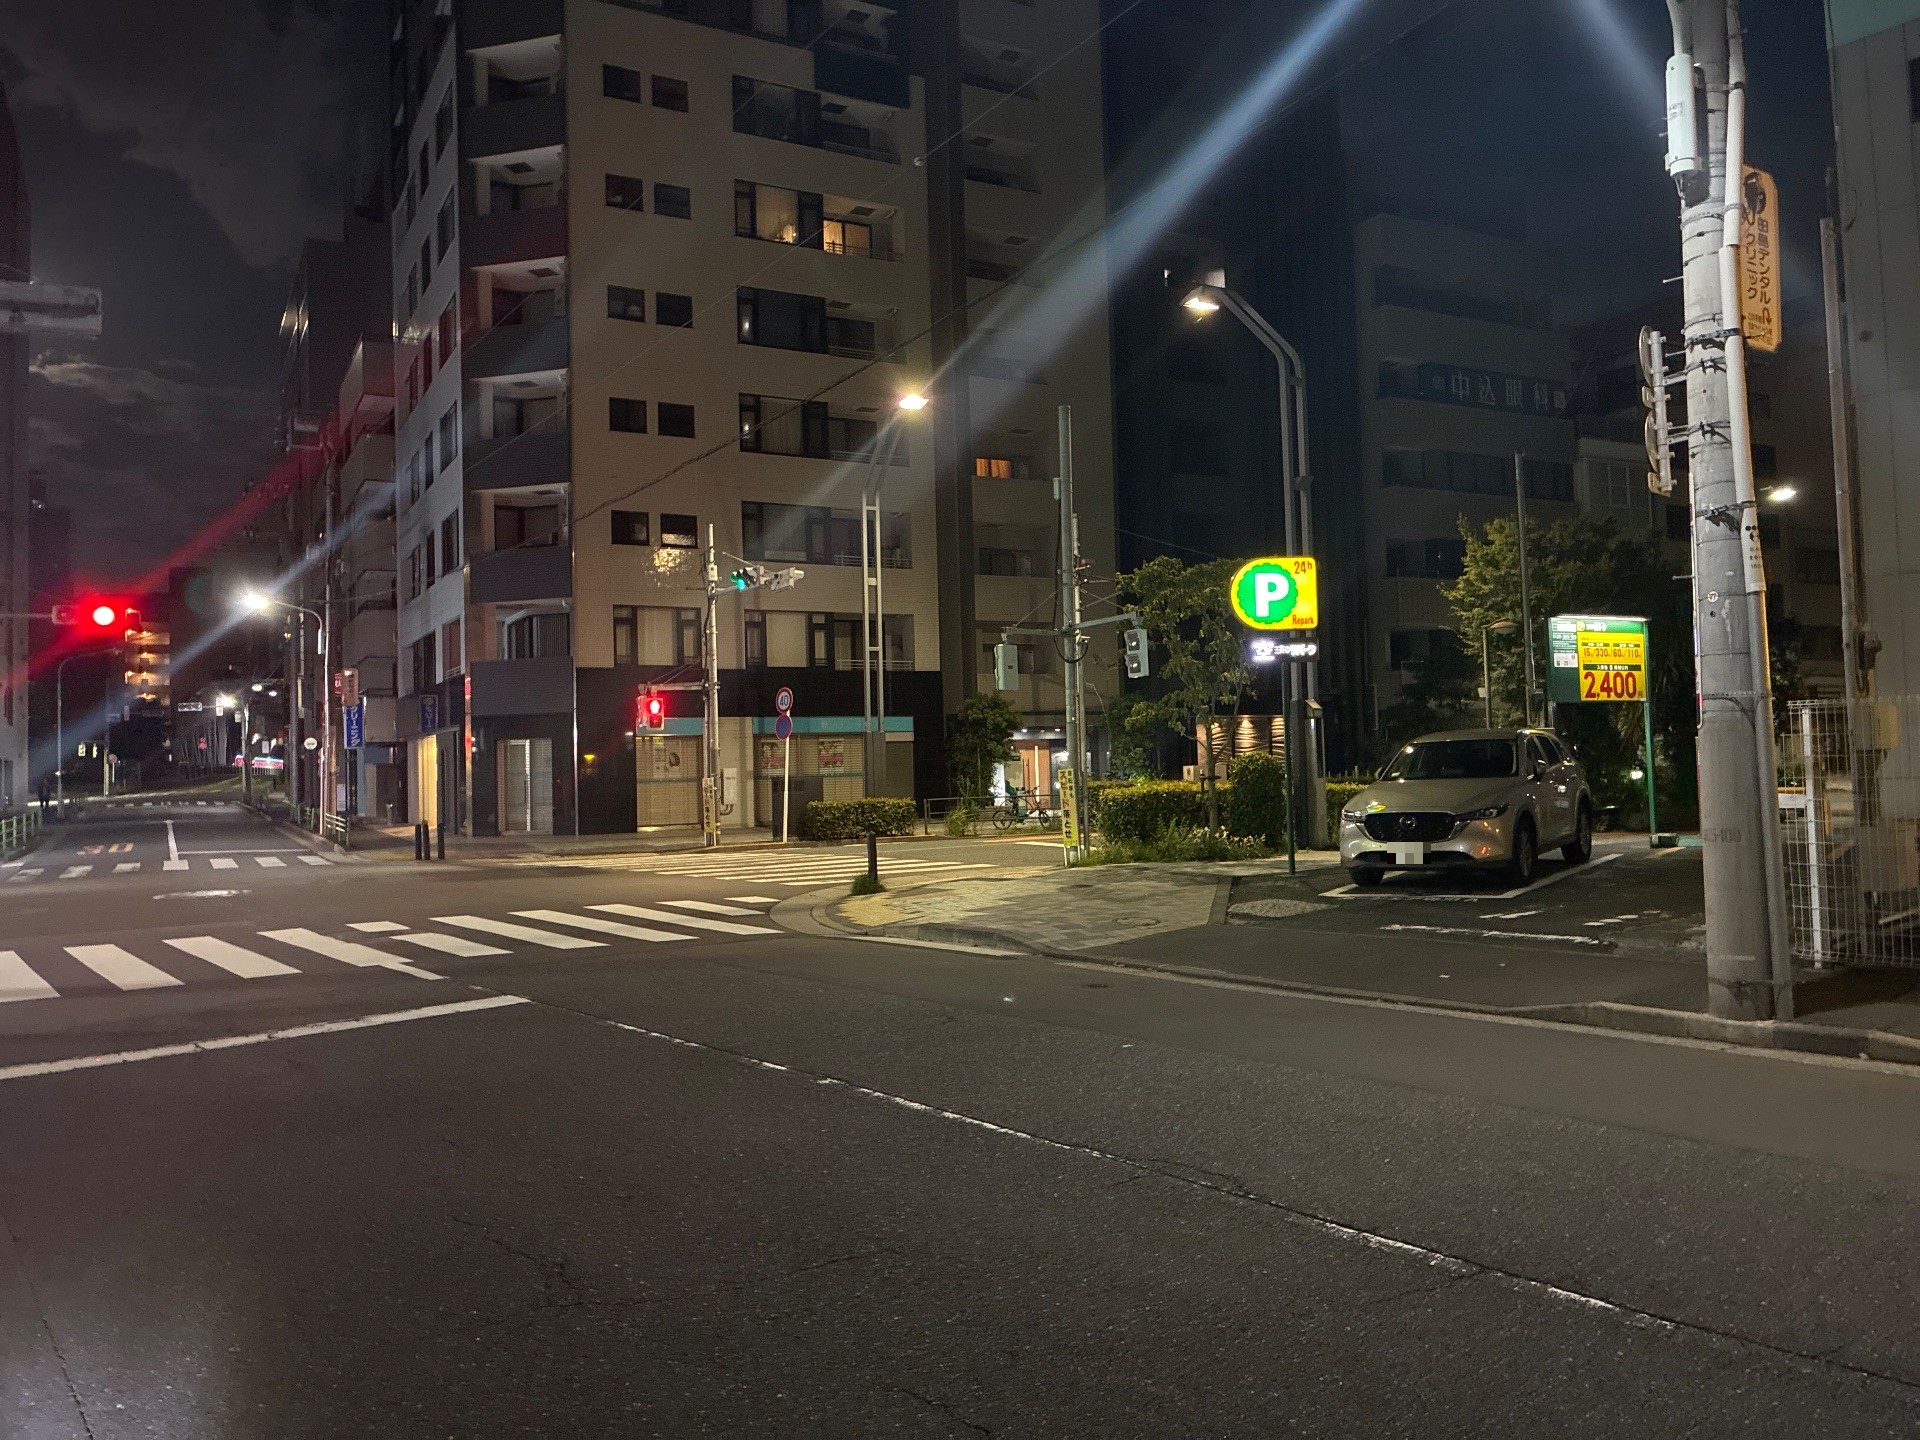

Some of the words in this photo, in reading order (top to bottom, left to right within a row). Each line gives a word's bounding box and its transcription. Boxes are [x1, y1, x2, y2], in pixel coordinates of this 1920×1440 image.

[1746, 232, 1758, 300] クリニック
[1451, 371, 1548, 411] 中込眼科
[1293, 560, 1313, 575] 24h
[1254, 572, 1290, 618] P
[1292, 614, 1315, 626] Repark
[779, 695, 788, 707] 40
[350, 706, 361, 747] クリーニング
[1059, 770, 1072, 838] スピード落とせ
